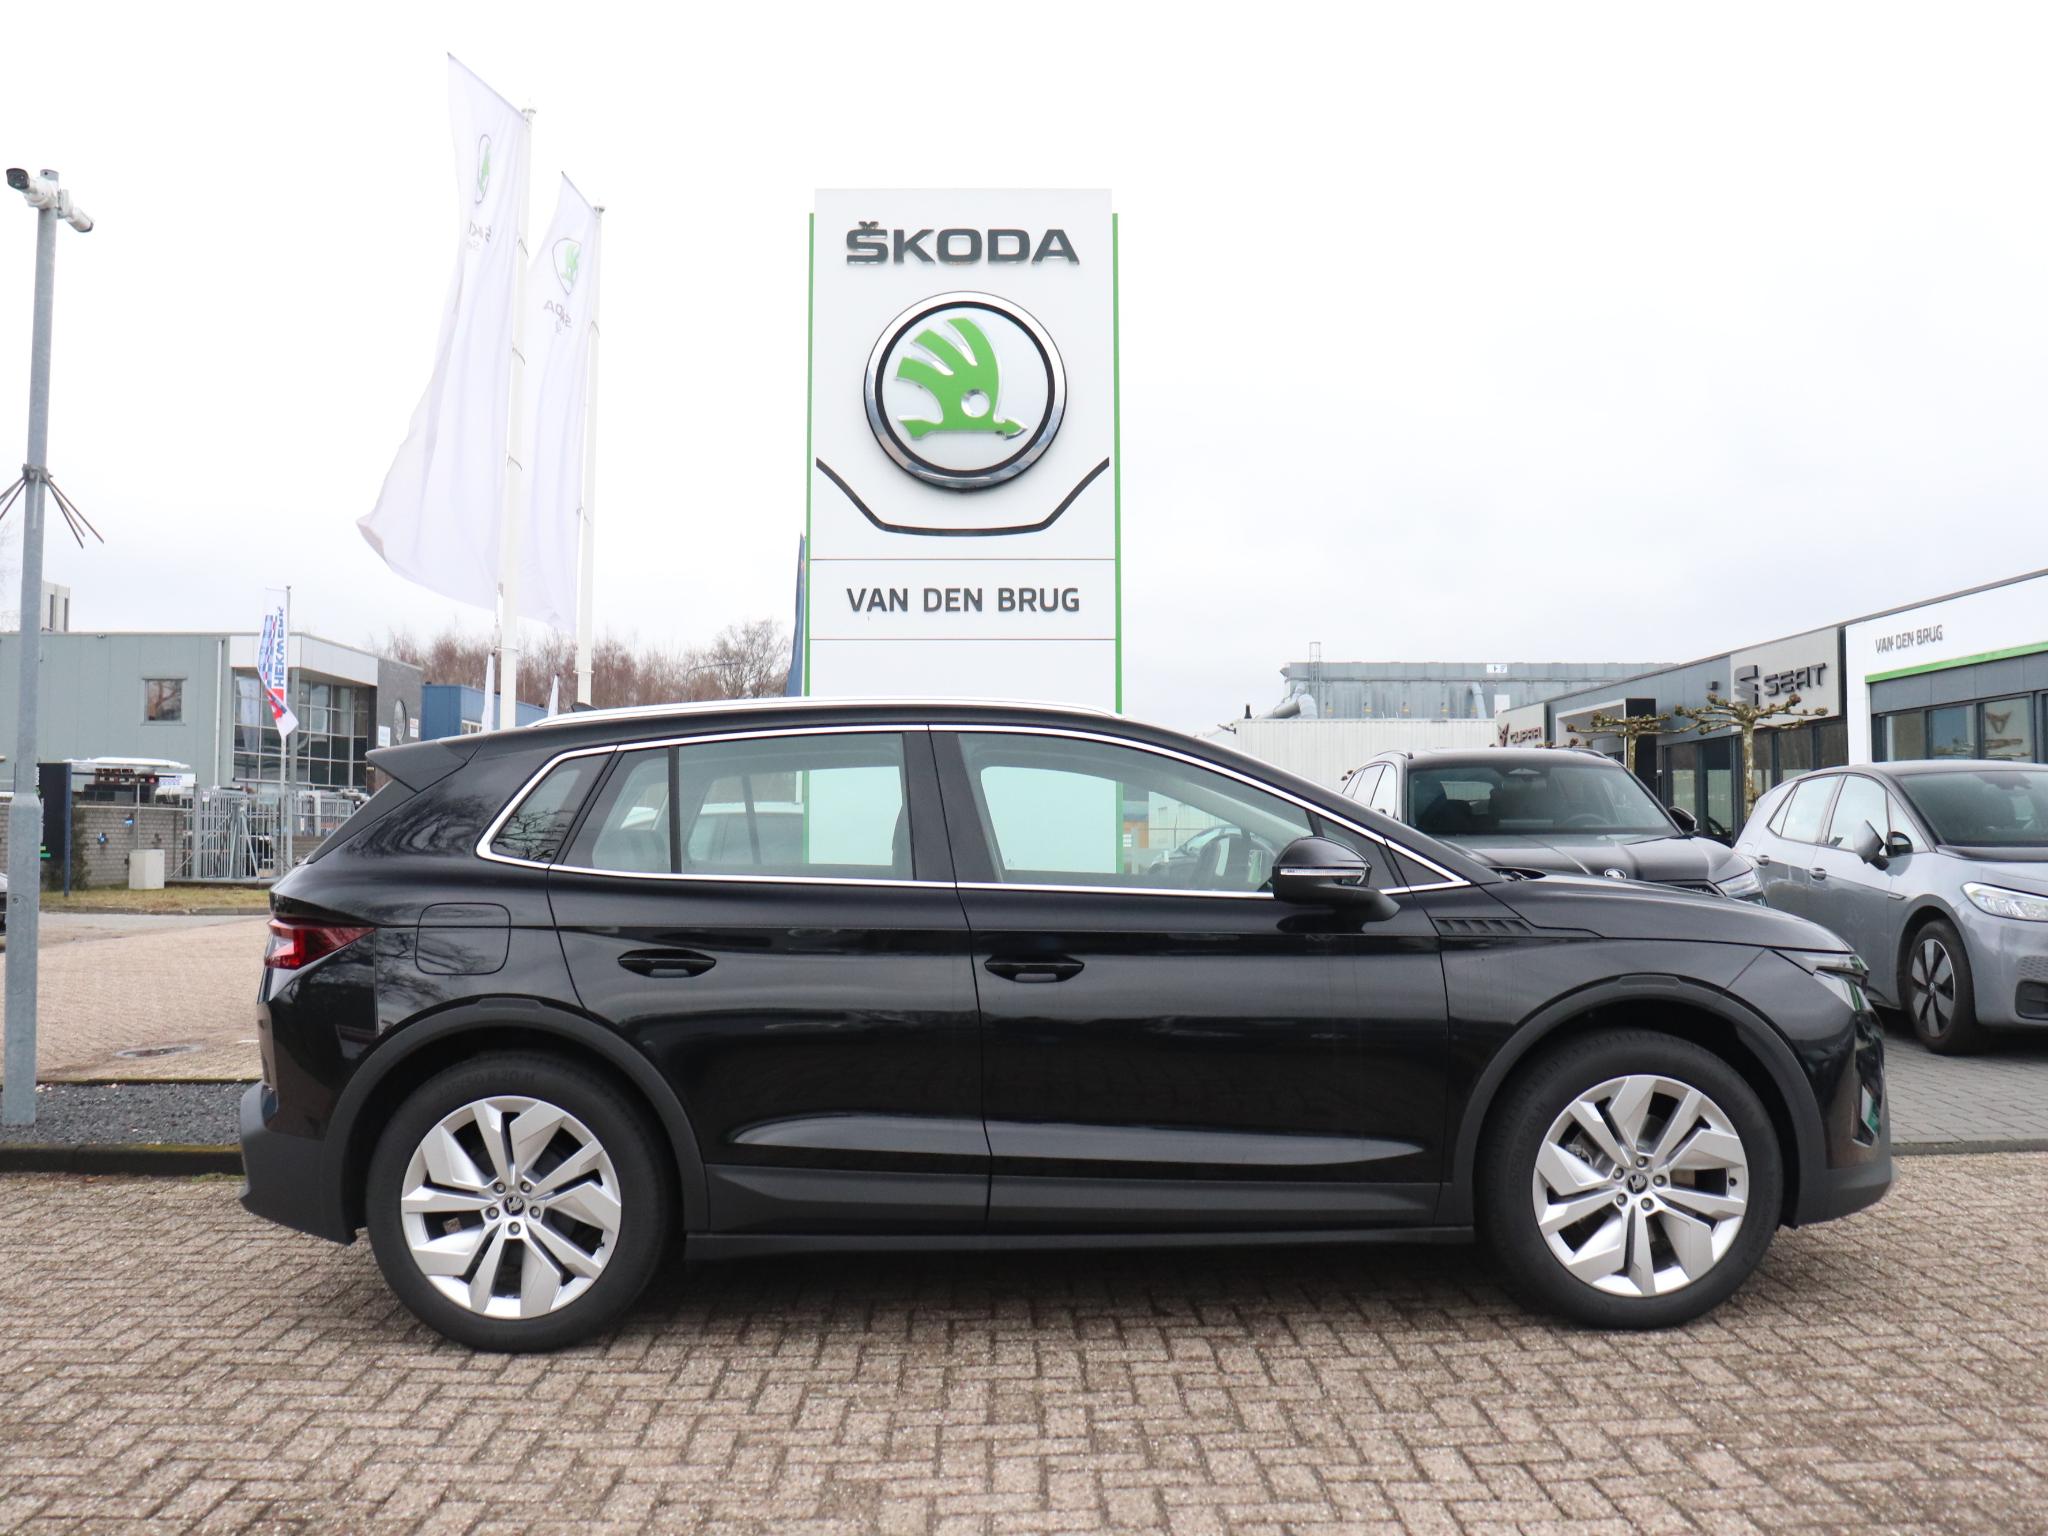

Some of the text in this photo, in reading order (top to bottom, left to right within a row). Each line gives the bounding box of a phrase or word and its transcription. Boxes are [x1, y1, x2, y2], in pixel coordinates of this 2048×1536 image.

[846, 221, 1081, 265] ŠKODA
[846, 587, 1080, 612] VAN DEN BRUG
[1875, 624, 1943, 654] VAN DEN BRUG
[1763, 662, 1827, 697] SEAT
